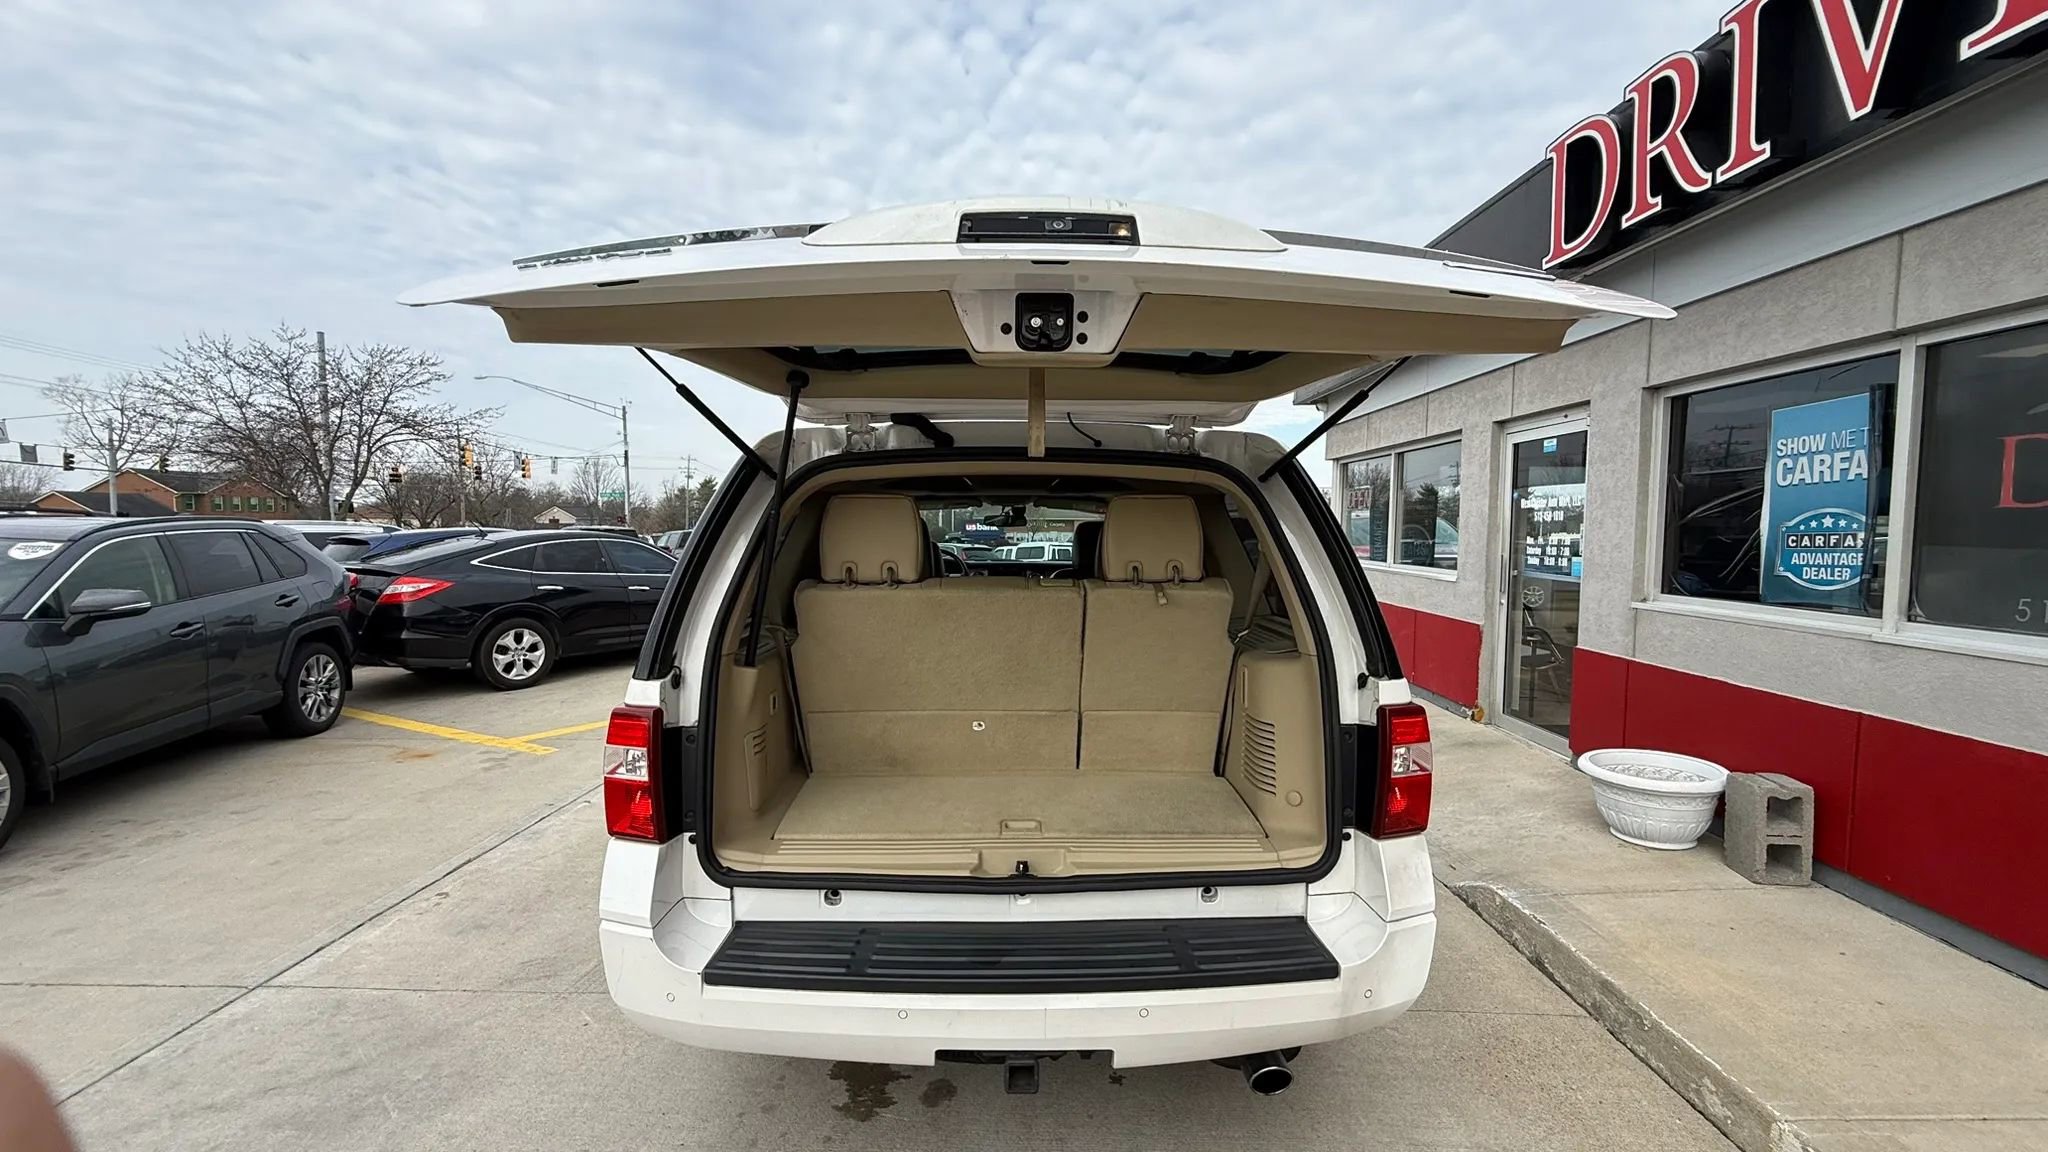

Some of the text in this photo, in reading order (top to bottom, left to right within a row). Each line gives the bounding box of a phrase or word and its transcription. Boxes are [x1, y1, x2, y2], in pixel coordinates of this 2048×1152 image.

[1776, 433, 1827, 457] SHOW
[1831, 429, 1857, 450] ME
[1791, 552, 1864, 566] ADVANTAGE
[1802, 567, 1851, 581] DEALER
